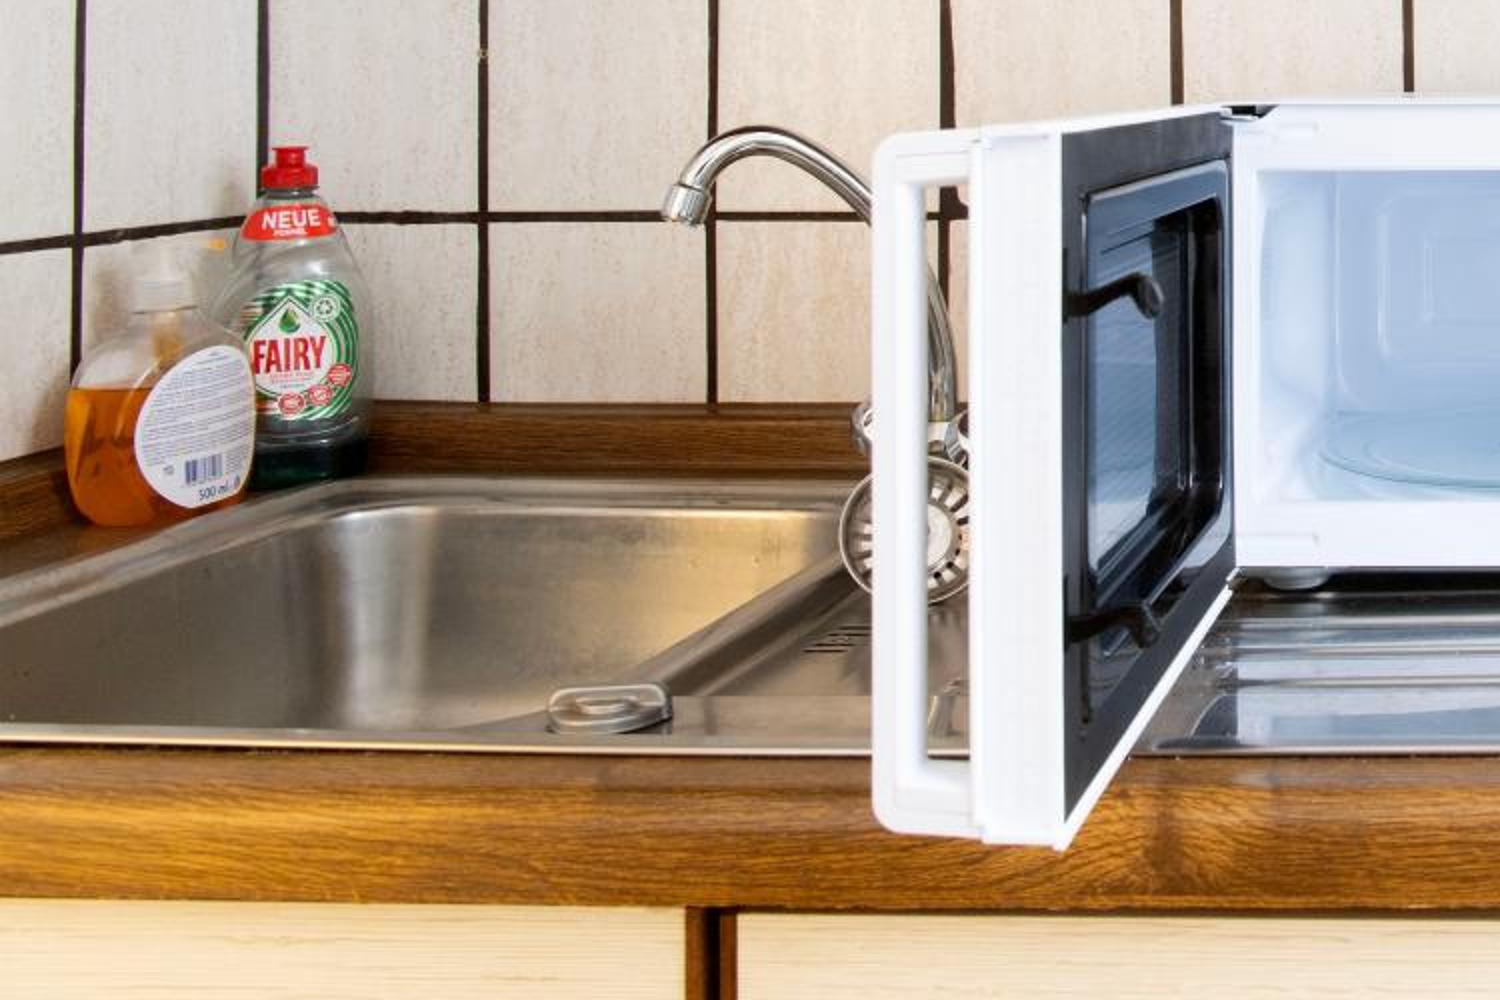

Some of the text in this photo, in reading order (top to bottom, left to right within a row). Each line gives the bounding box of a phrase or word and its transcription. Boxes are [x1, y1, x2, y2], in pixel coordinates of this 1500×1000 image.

[261, 208, 321, 230] NEUE
[252, 335, 327, 375] FAIRY
[199, 485, 217, 501] 500
